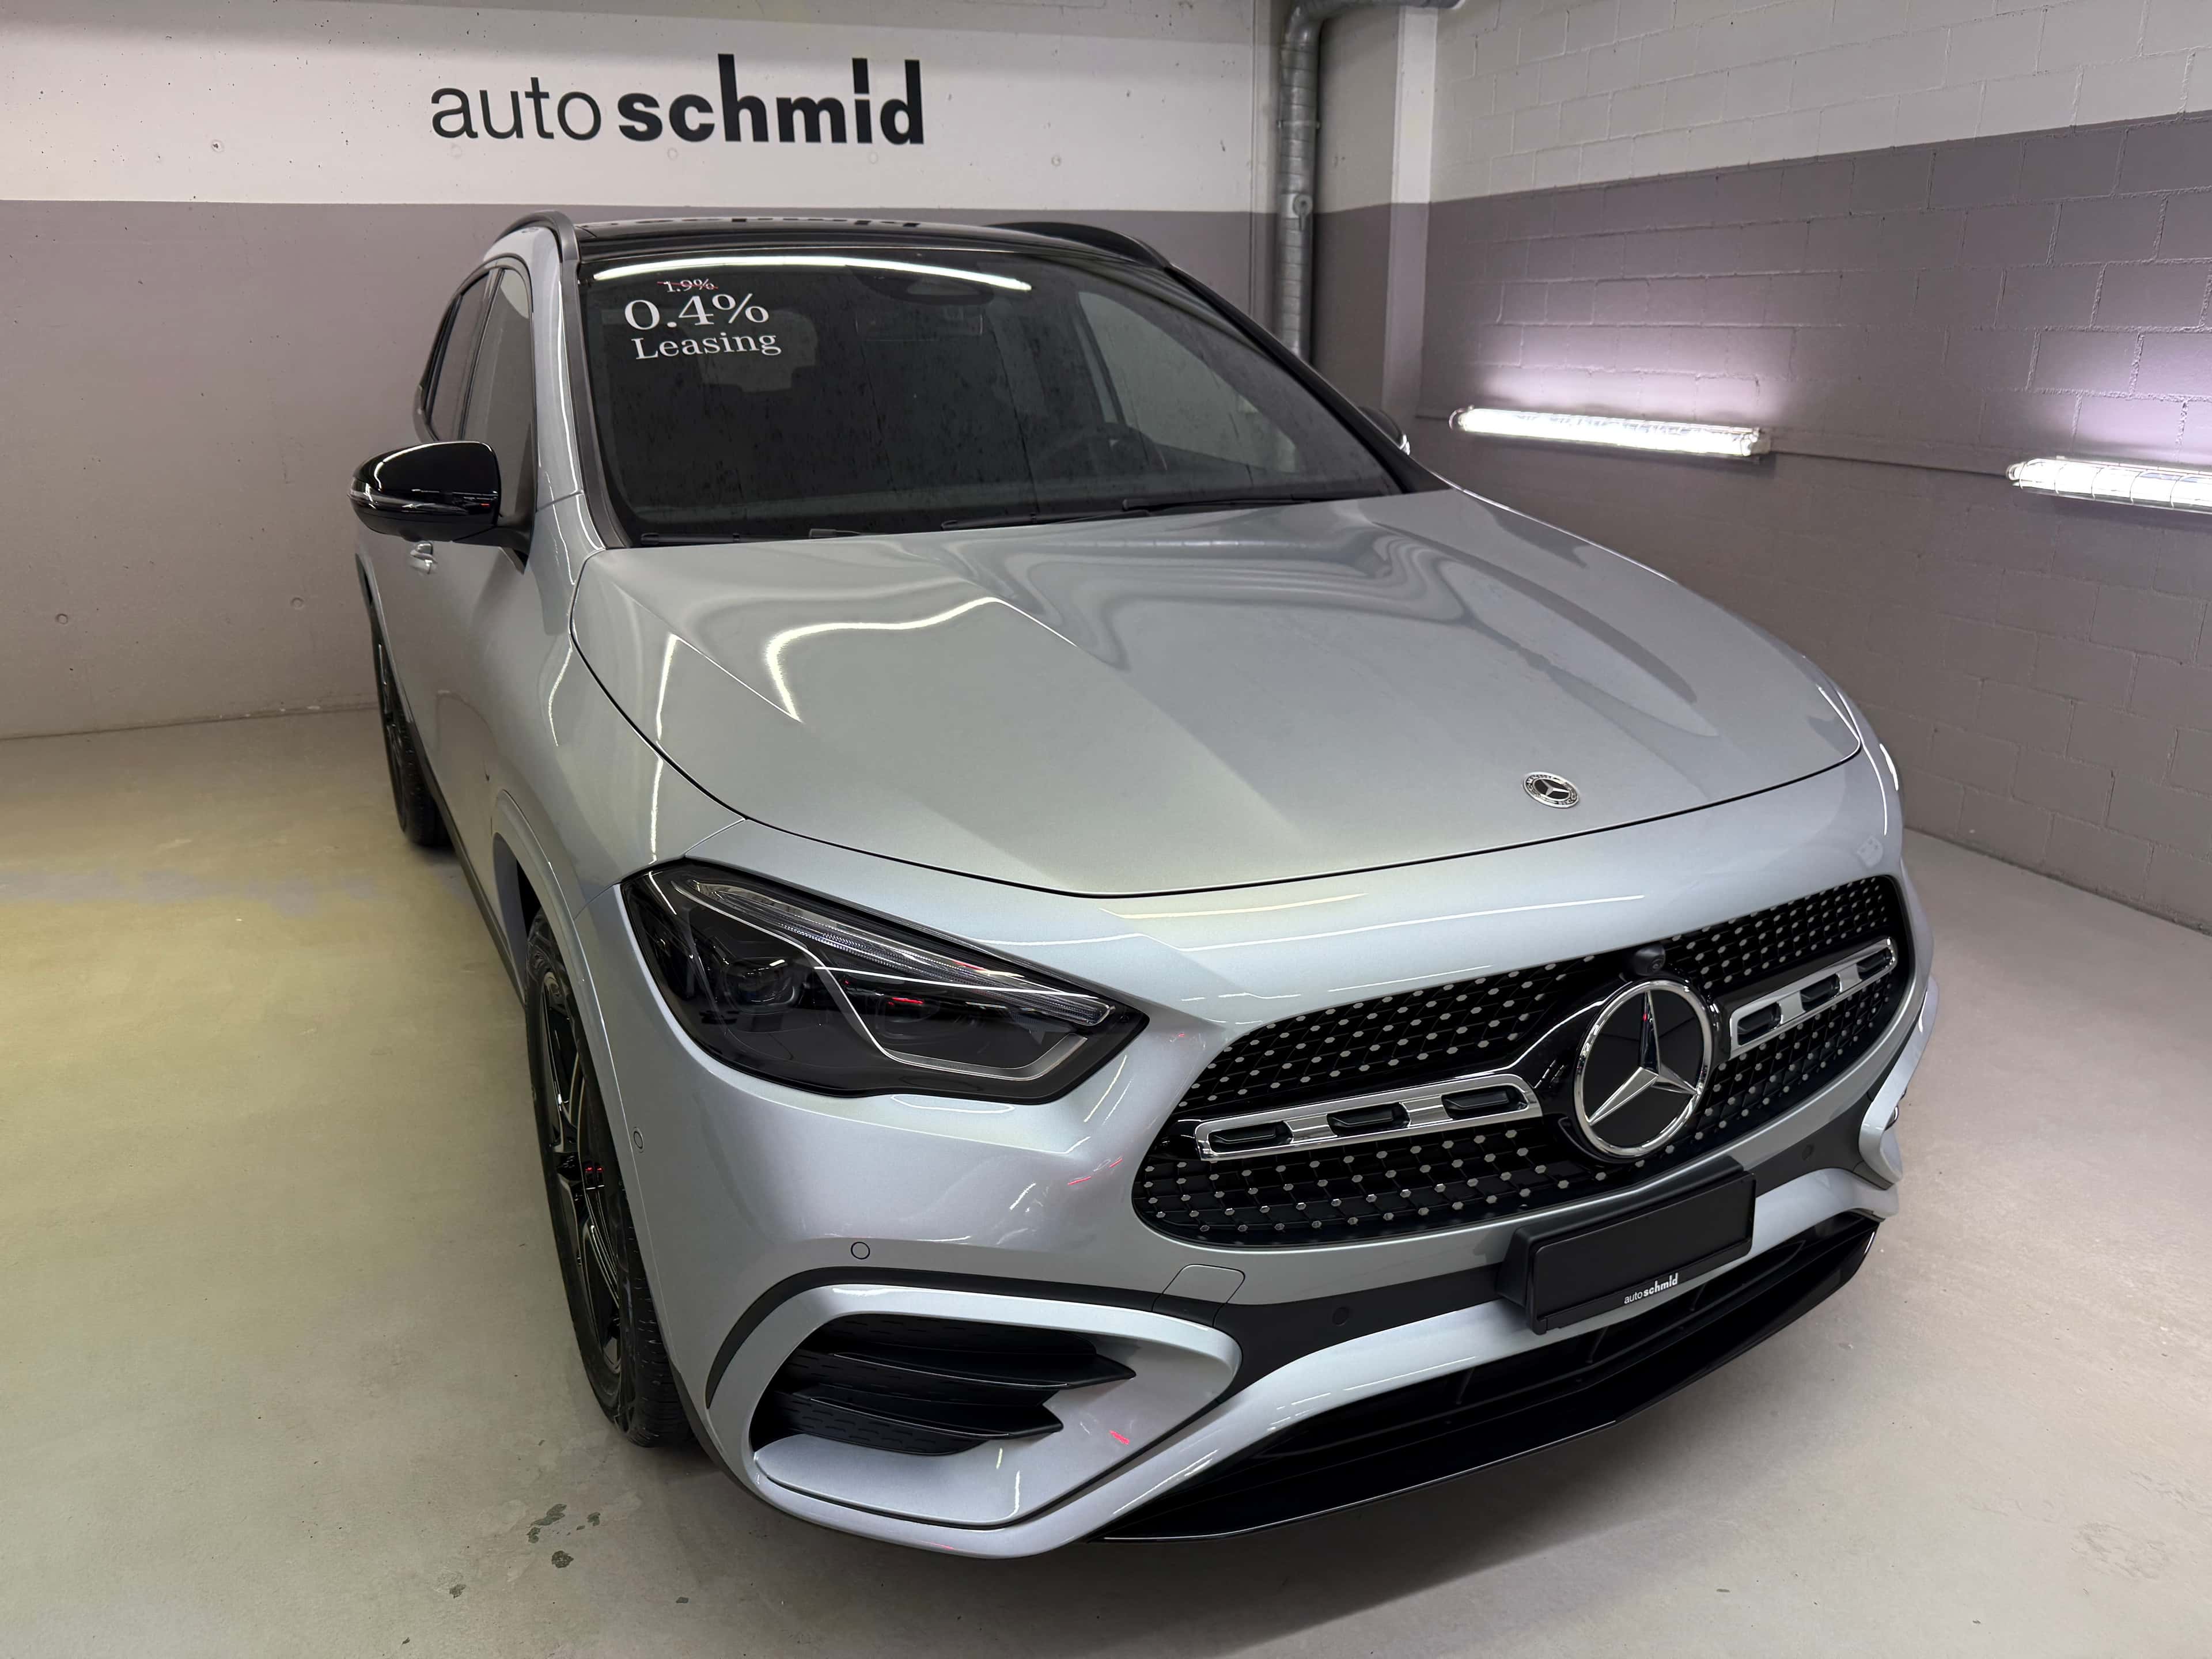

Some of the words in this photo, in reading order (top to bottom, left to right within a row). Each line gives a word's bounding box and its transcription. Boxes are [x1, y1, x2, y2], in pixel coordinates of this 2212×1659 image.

[430, 77, 602, 141] auto
[618, 53, 924, 145] schmid
[664, 278, 715, 293] 1.9%
[624, 293, 770, 331] 0.4%
[631, 331, 782, 359] Leasing
[1623, 1291, 1643, 1304] auto
[1643, 1272, 1679, 1297] schmid
